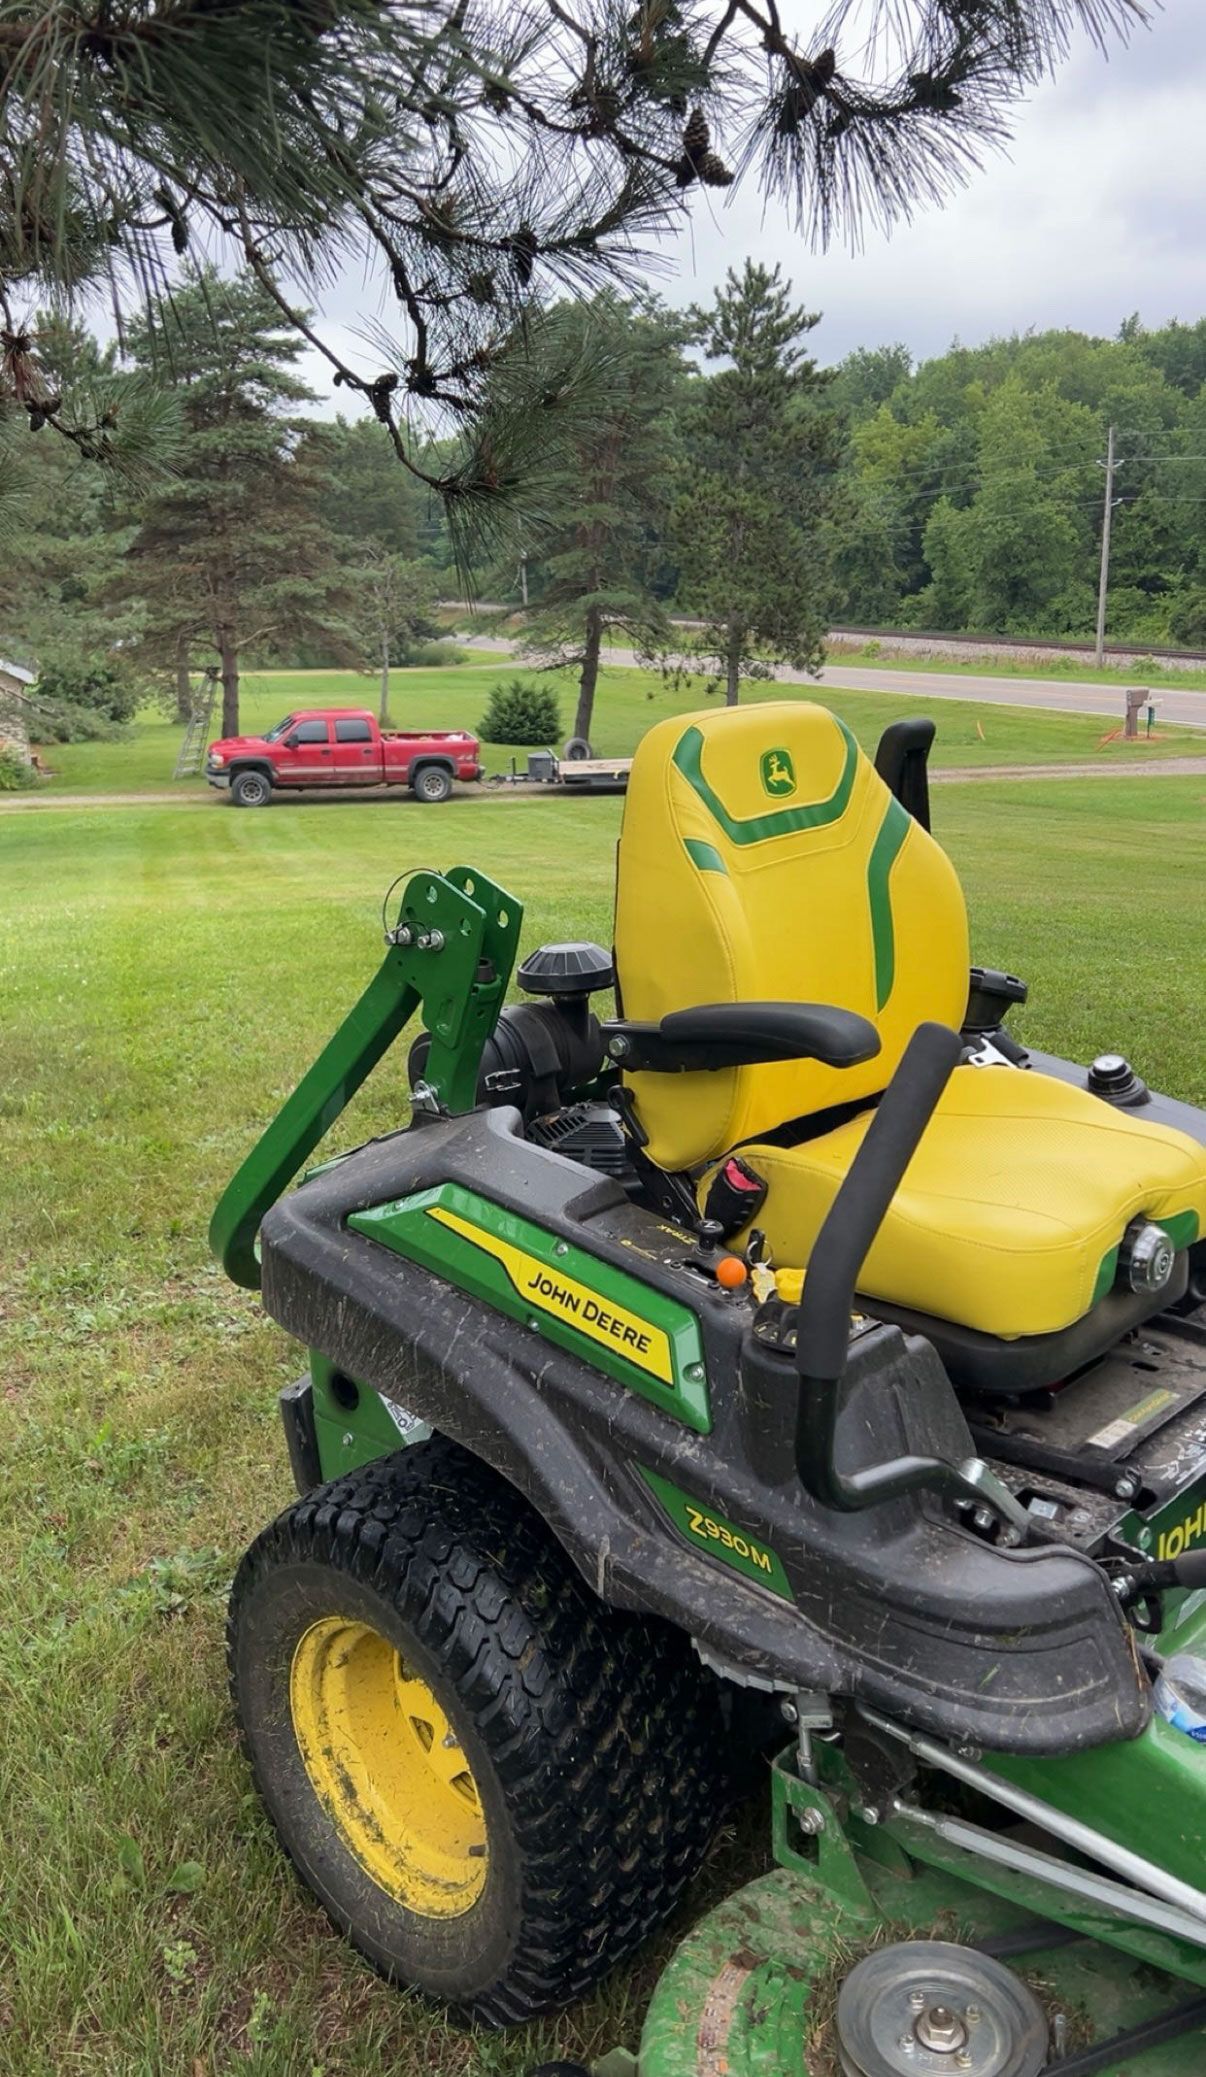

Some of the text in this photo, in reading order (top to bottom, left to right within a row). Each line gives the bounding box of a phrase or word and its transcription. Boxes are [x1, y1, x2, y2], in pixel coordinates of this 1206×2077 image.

[527, 1272, 653, 1354] JOHN DEERE
[685, 1505, 773, 1574] Z930M
[1158, 1502, 1206, 1561] JOH
